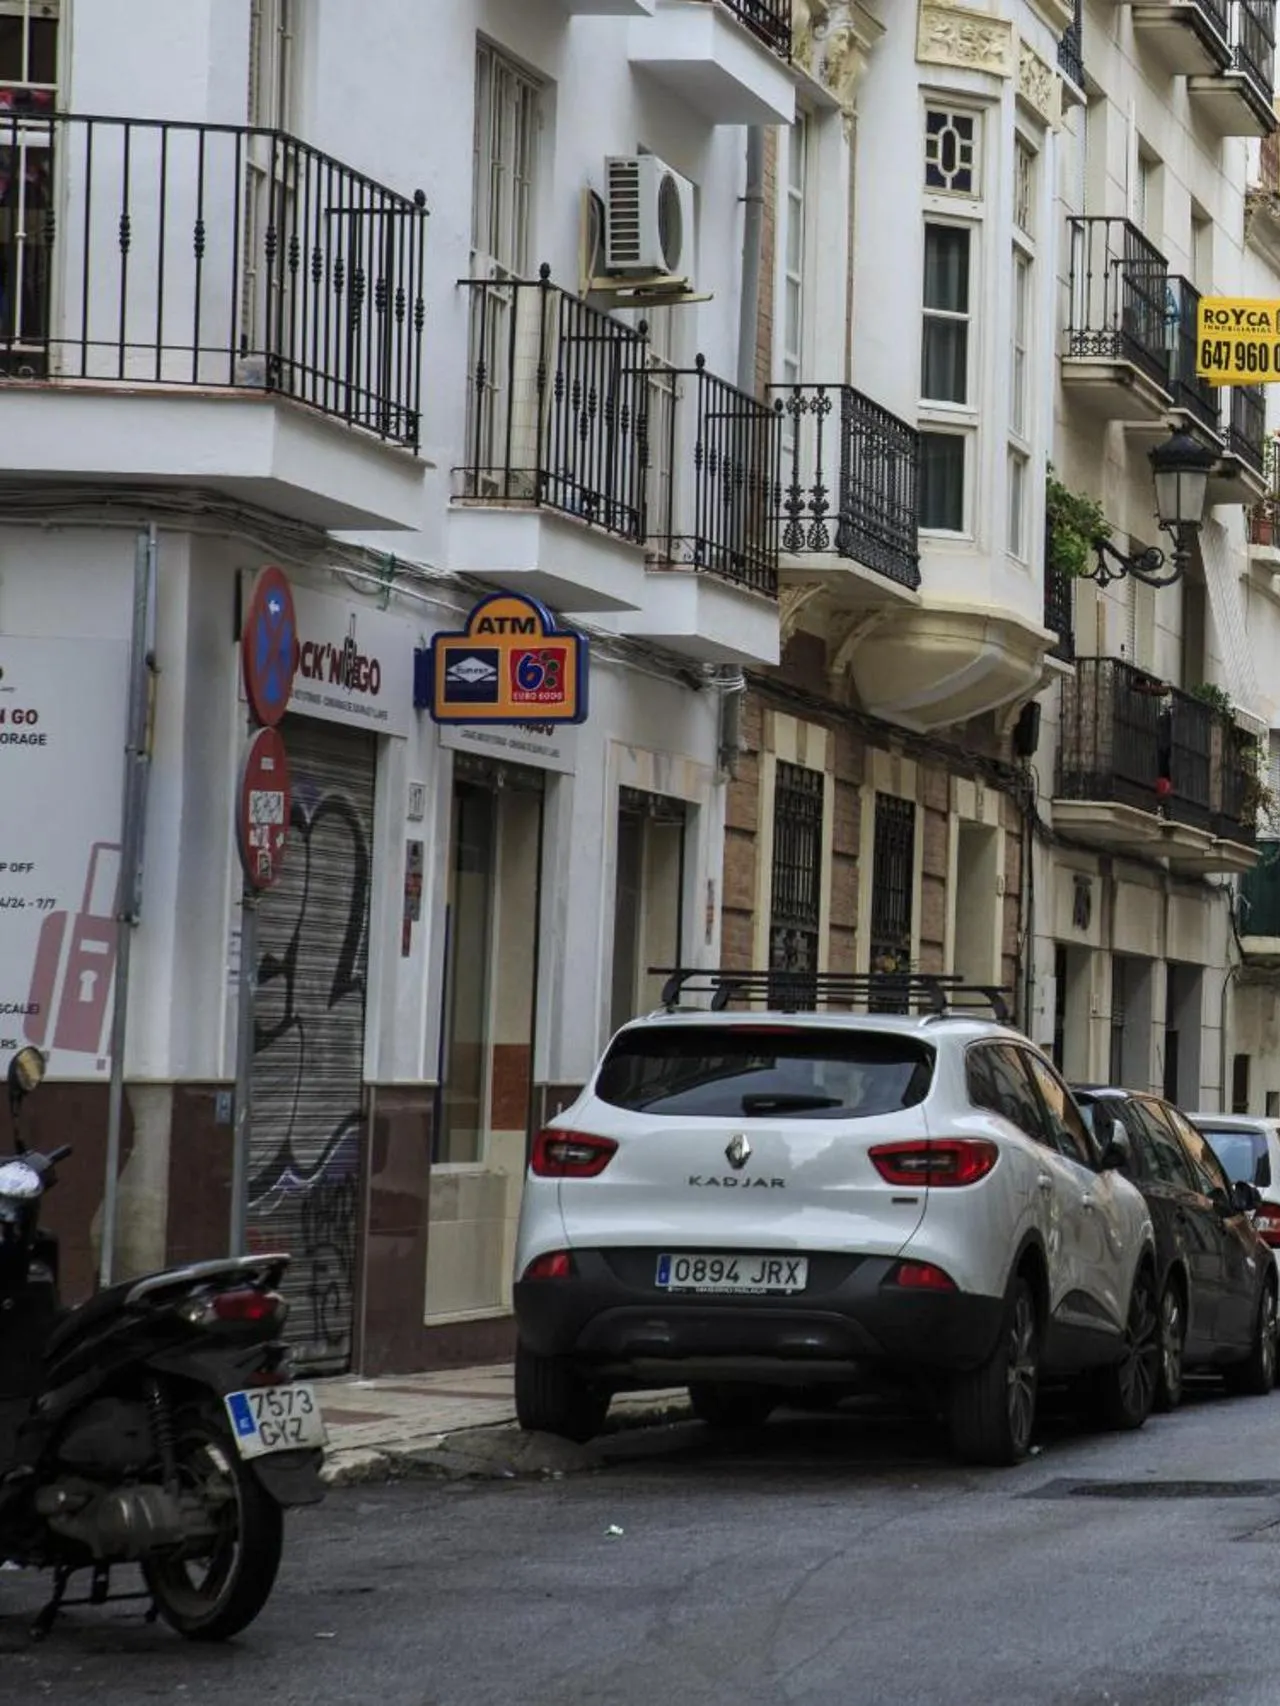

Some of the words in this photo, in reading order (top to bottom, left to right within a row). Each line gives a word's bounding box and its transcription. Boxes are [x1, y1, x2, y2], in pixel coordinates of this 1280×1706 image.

[1203, 308, 1271, 327] ROYCA
[1201, 339, 1231, 370] 647
[1235, 342, 1269, 372] 960
[477, 616, 536, 635] ATM
[11, 708, 39, 726] GO
[10, 862, 35, 873] OFF
[688, 1176, 786, 1188] KADJAR
[675, 1258, 740, 1283] 0894
[751, 1260, 800, 1285] JRX
[249, 1388, 313, 1419] 7573
